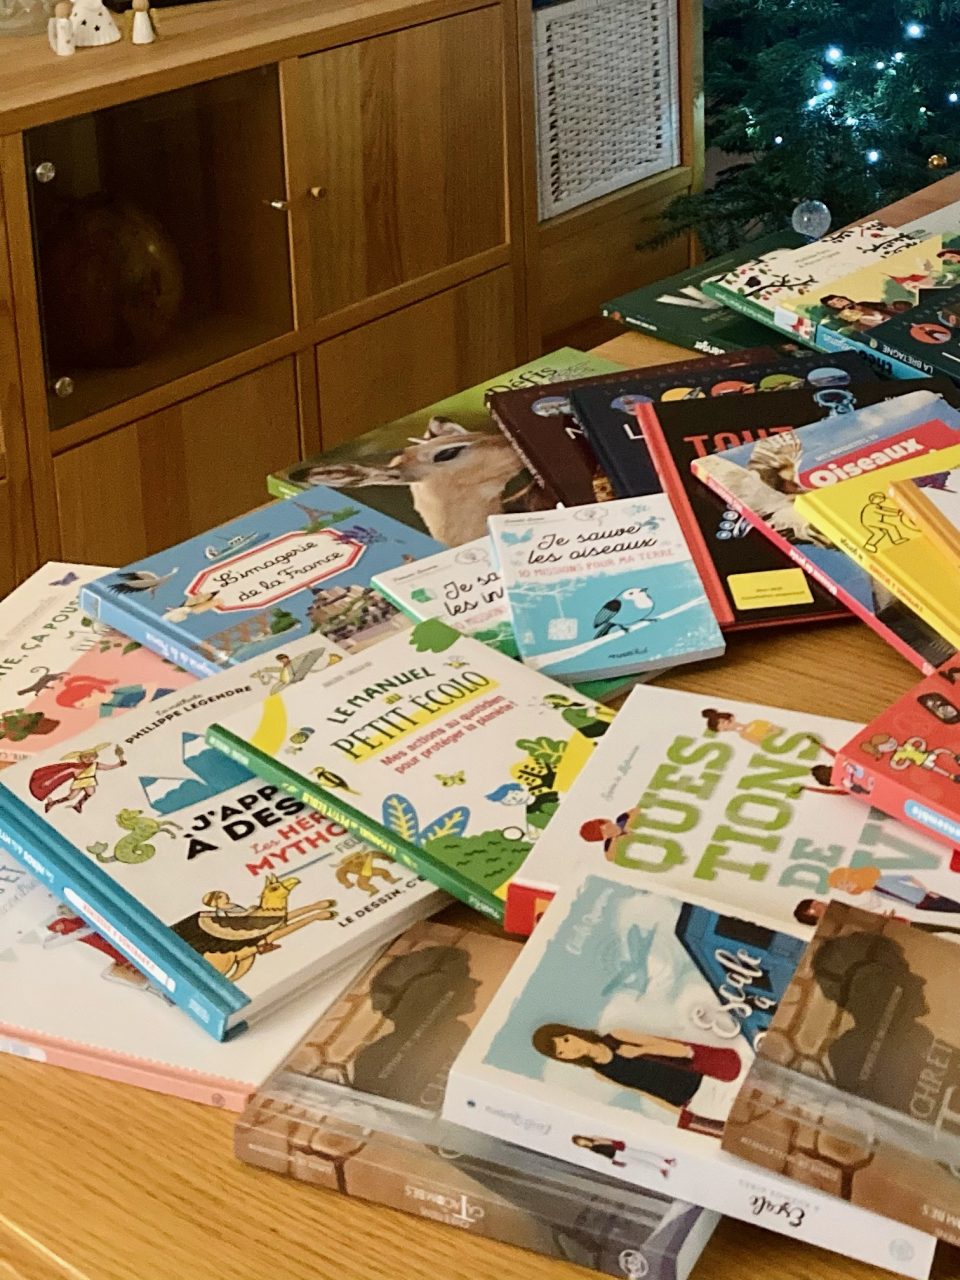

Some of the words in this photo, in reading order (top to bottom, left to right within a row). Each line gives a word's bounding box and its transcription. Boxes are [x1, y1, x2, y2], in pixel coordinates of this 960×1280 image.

[881, 343, 922, 370] BRETAGNE
[922, 363, 934, 375] LA
[808, 436, 925, 488] Oiseaux
[527, 547, 563, 566] les
[569, 536, 659, 559] oiseaux
[537, 532, 570, 551] Je
[576, 523, 644, 544] sauve
[212, 540, 318, 588] L'imagerie
[238, 587, 262, 603] de
[261, 578, 285, 593] la
[277, 551, 345, 582] France
[518, 568, 531, 578] 10
[533, 562, 584, 578] MISSIONS
[586, 558, 614, 571] POUR
[618, 555, 636, 566] MA
[638, 549, 675, 563] TERRE
[443, 580, 473, 601] Je
[443, 599, 479, 617] les
[20, 631, 51, 652] ÇA
[326, 706, 357, 725] LE
[346, 666, 436, 709] MANUEL
[125, 710, 183, 745] PHILIPPE
[183, 684, 253, 713] LEGENDRE
[329, 706, 419, 760] PETIT
[408, 670, 491, 715] ÉCOLO
[380, 749, 408, 767] Mes
[406, 727, 447, 752] actions
[445, 719, 461, 729] au
[459, 694, 507, 722] quotidien
[394, 756, 421, 775] pour
[420, 729, 466, 759] protéger
[464, 722, 478, 732] la
[693, 727, 823, 883] TIONS
[909, 804, 959, 839] ensemble
[183, 833, 220, 861] À
[778, 836, 843, 895] DE
[337, 914, 354, 929] LE
